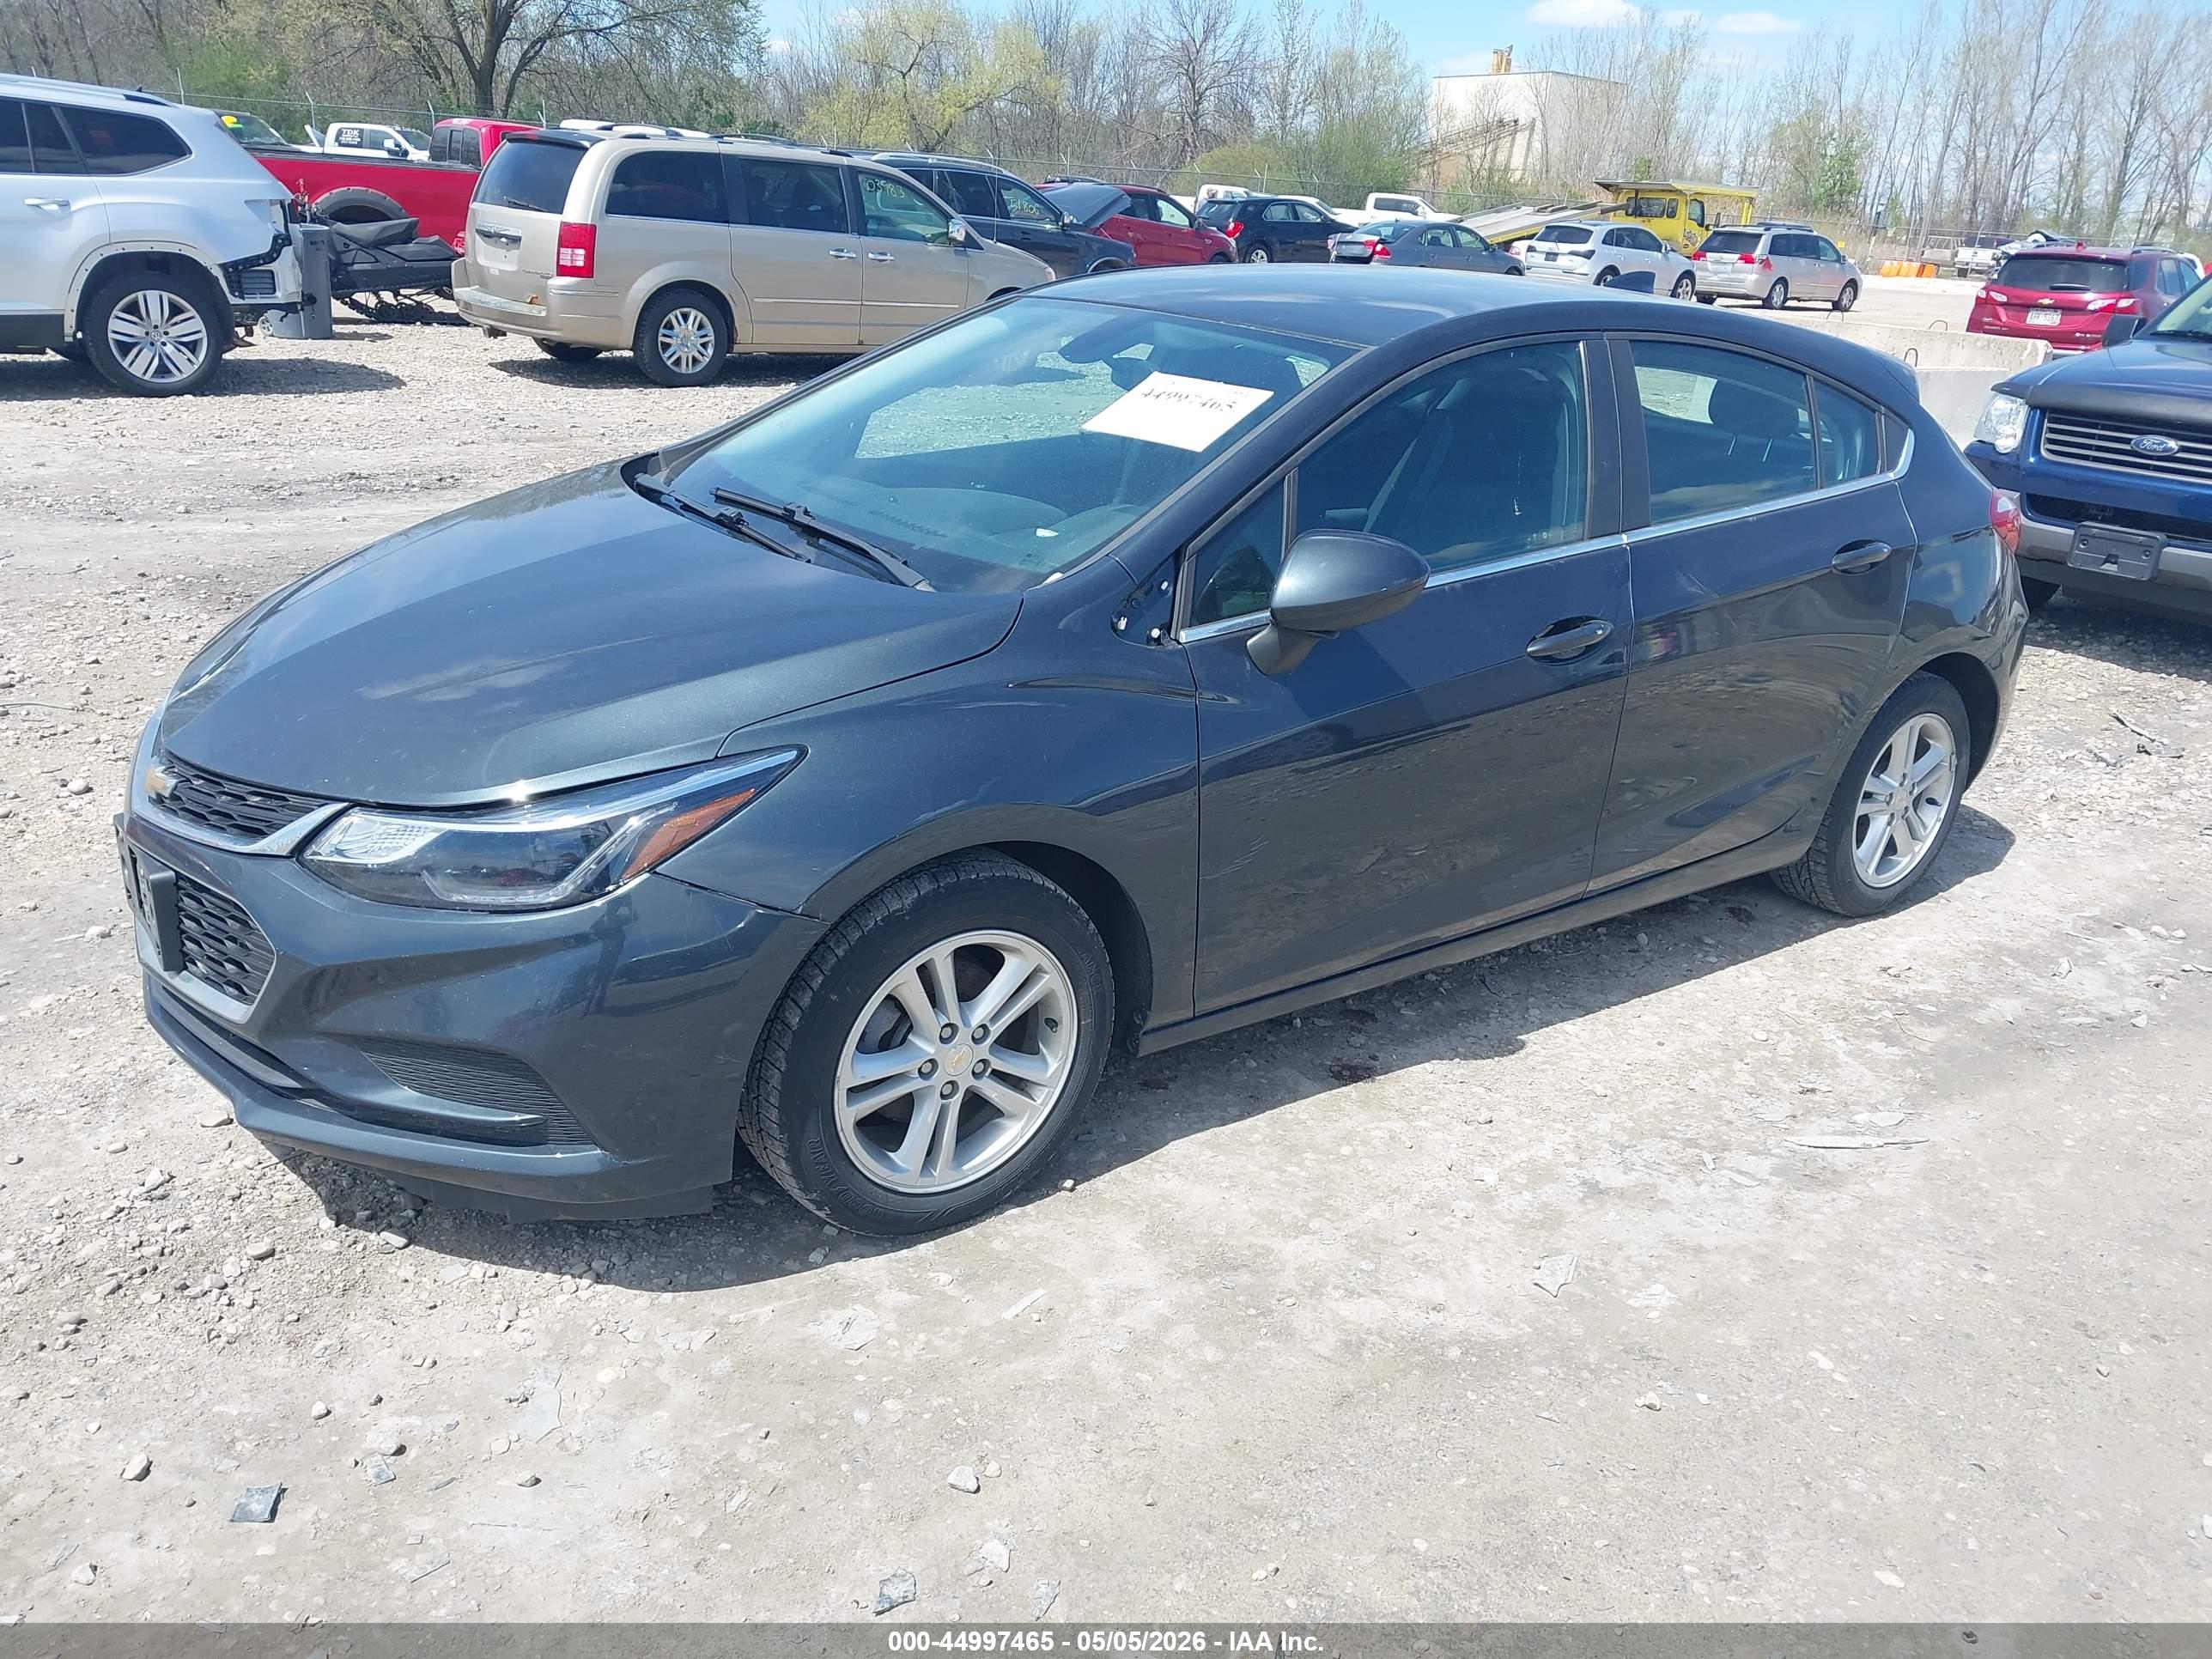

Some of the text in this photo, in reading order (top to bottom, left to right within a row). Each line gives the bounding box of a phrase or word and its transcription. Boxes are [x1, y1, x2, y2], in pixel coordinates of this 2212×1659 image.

[866, 179, 905, 198] 03983
[1010, 198, 1040, 215] 51806
[2139, 438, 2166, 452] Ford
